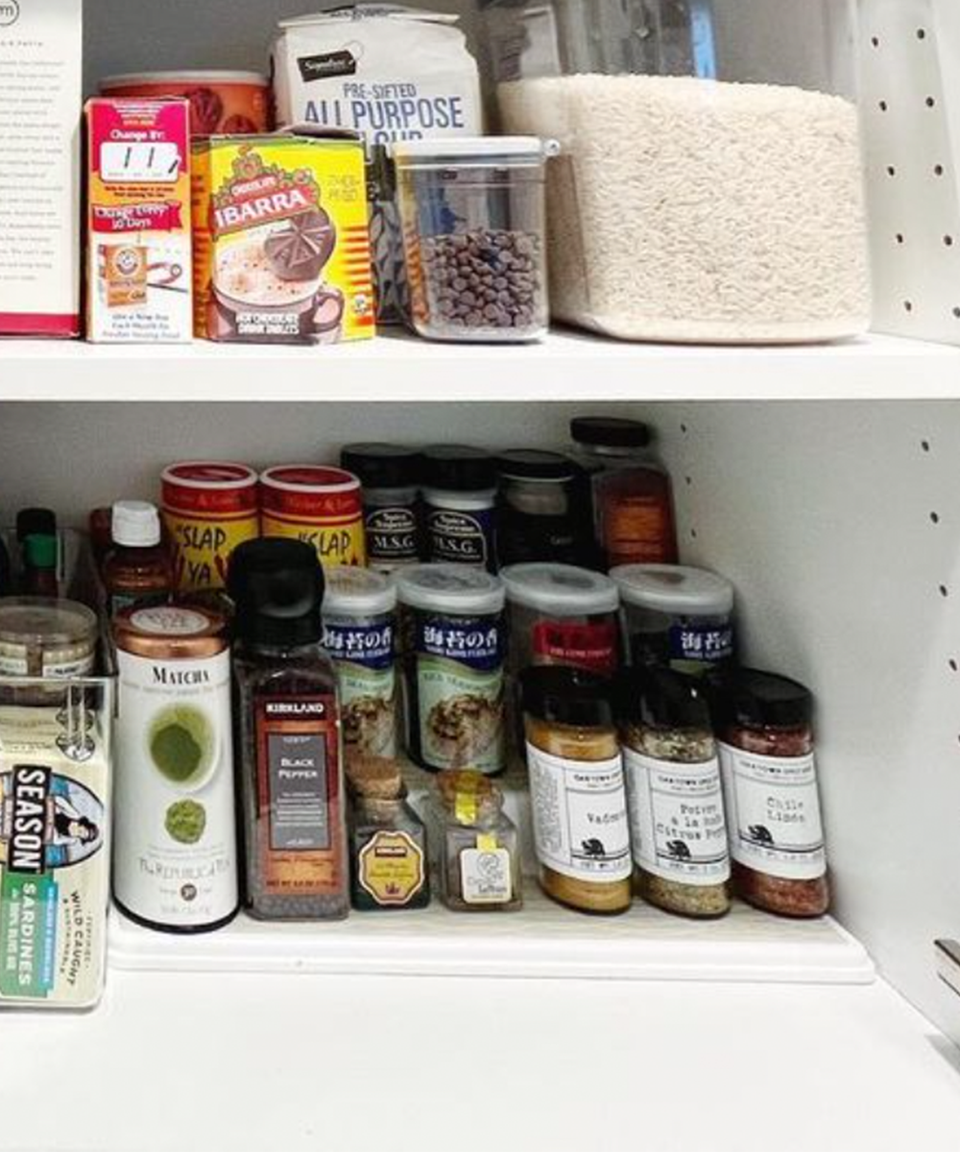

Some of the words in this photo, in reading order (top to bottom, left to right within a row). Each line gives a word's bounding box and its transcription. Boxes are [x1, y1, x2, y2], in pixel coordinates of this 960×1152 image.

[342, 82, 417, 99] PRE-SIFTED
[350, 97, 465, 130] PURPOSE
[110, 129, 147, 141] Change
[214, 189, 307, 228] IBARRA
[189, 561, 212, 583] YA
[266, 702, 324, 715] KIRKLAND
[12, 769, 46, 868] SEASON
[70, 891, 83, 926] WILD
[18, 883, 37, 986] SARDINES
[66, 930, 83, 986] CAUGHT
